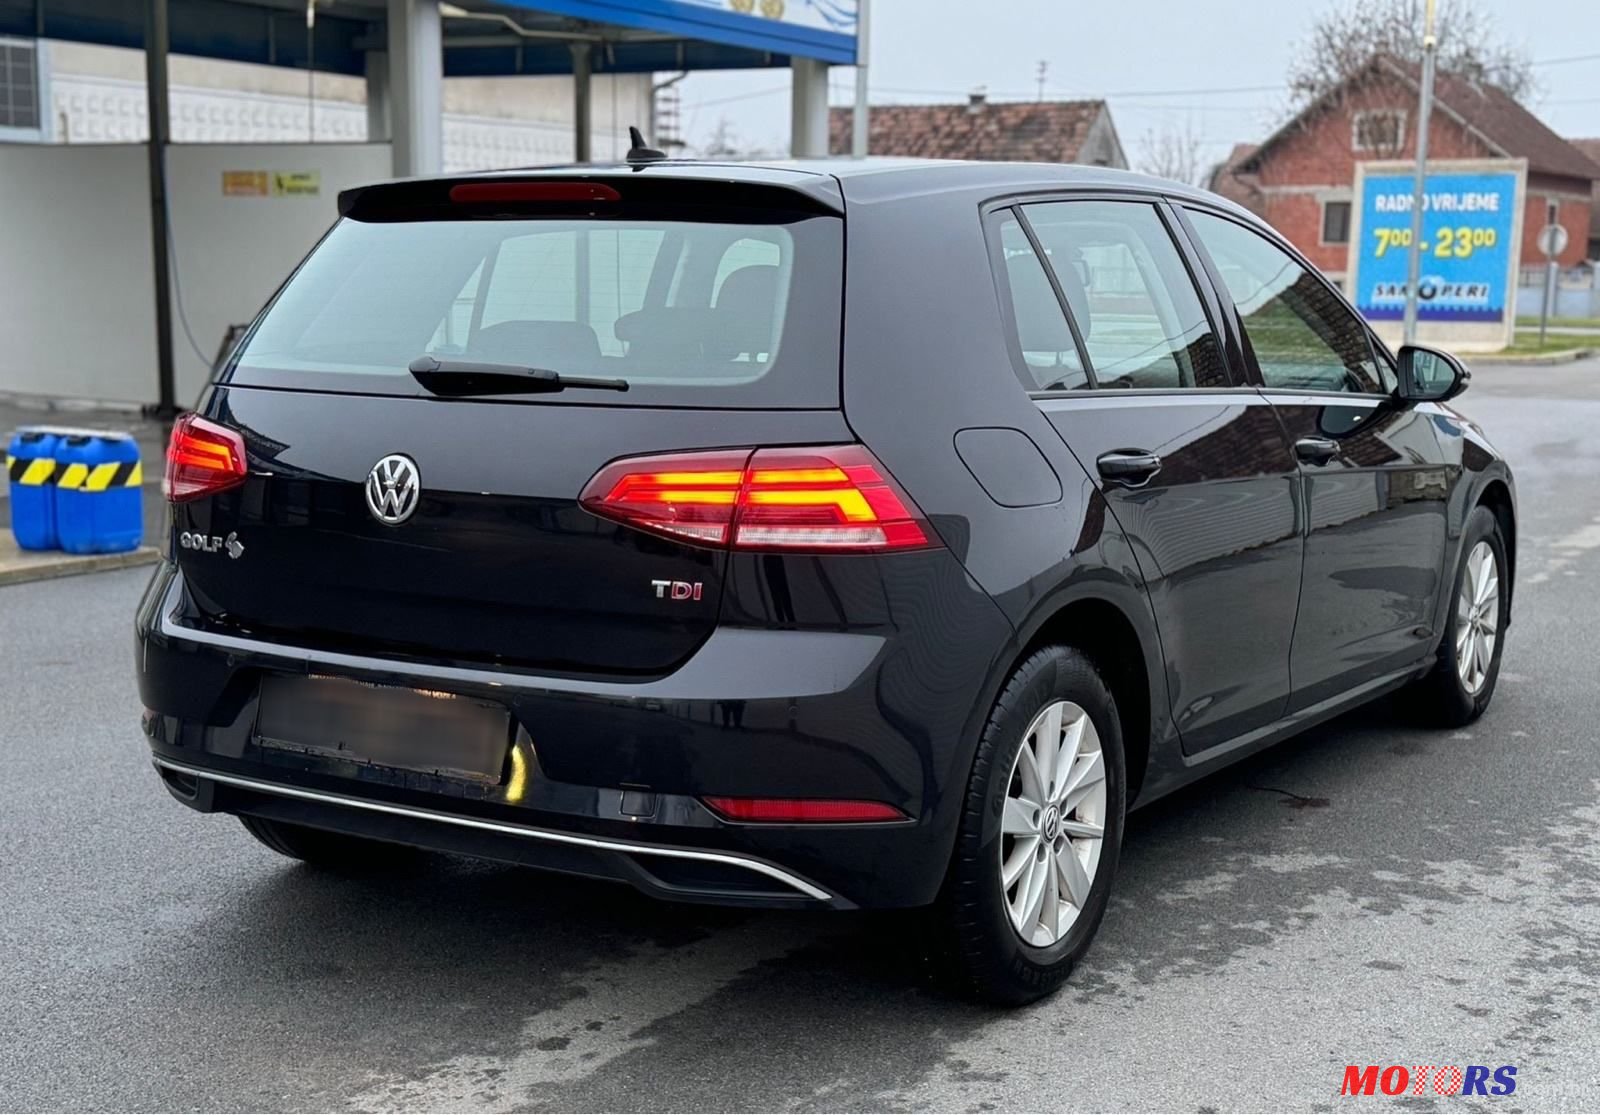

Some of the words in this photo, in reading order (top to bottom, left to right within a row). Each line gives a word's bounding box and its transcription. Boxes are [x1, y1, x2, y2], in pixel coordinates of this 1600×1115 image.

[1431, 192, 1500, 211] VRIJEME
[180, 531, 223, 553] GOLF
[651, 579, 703, 601] TDI
